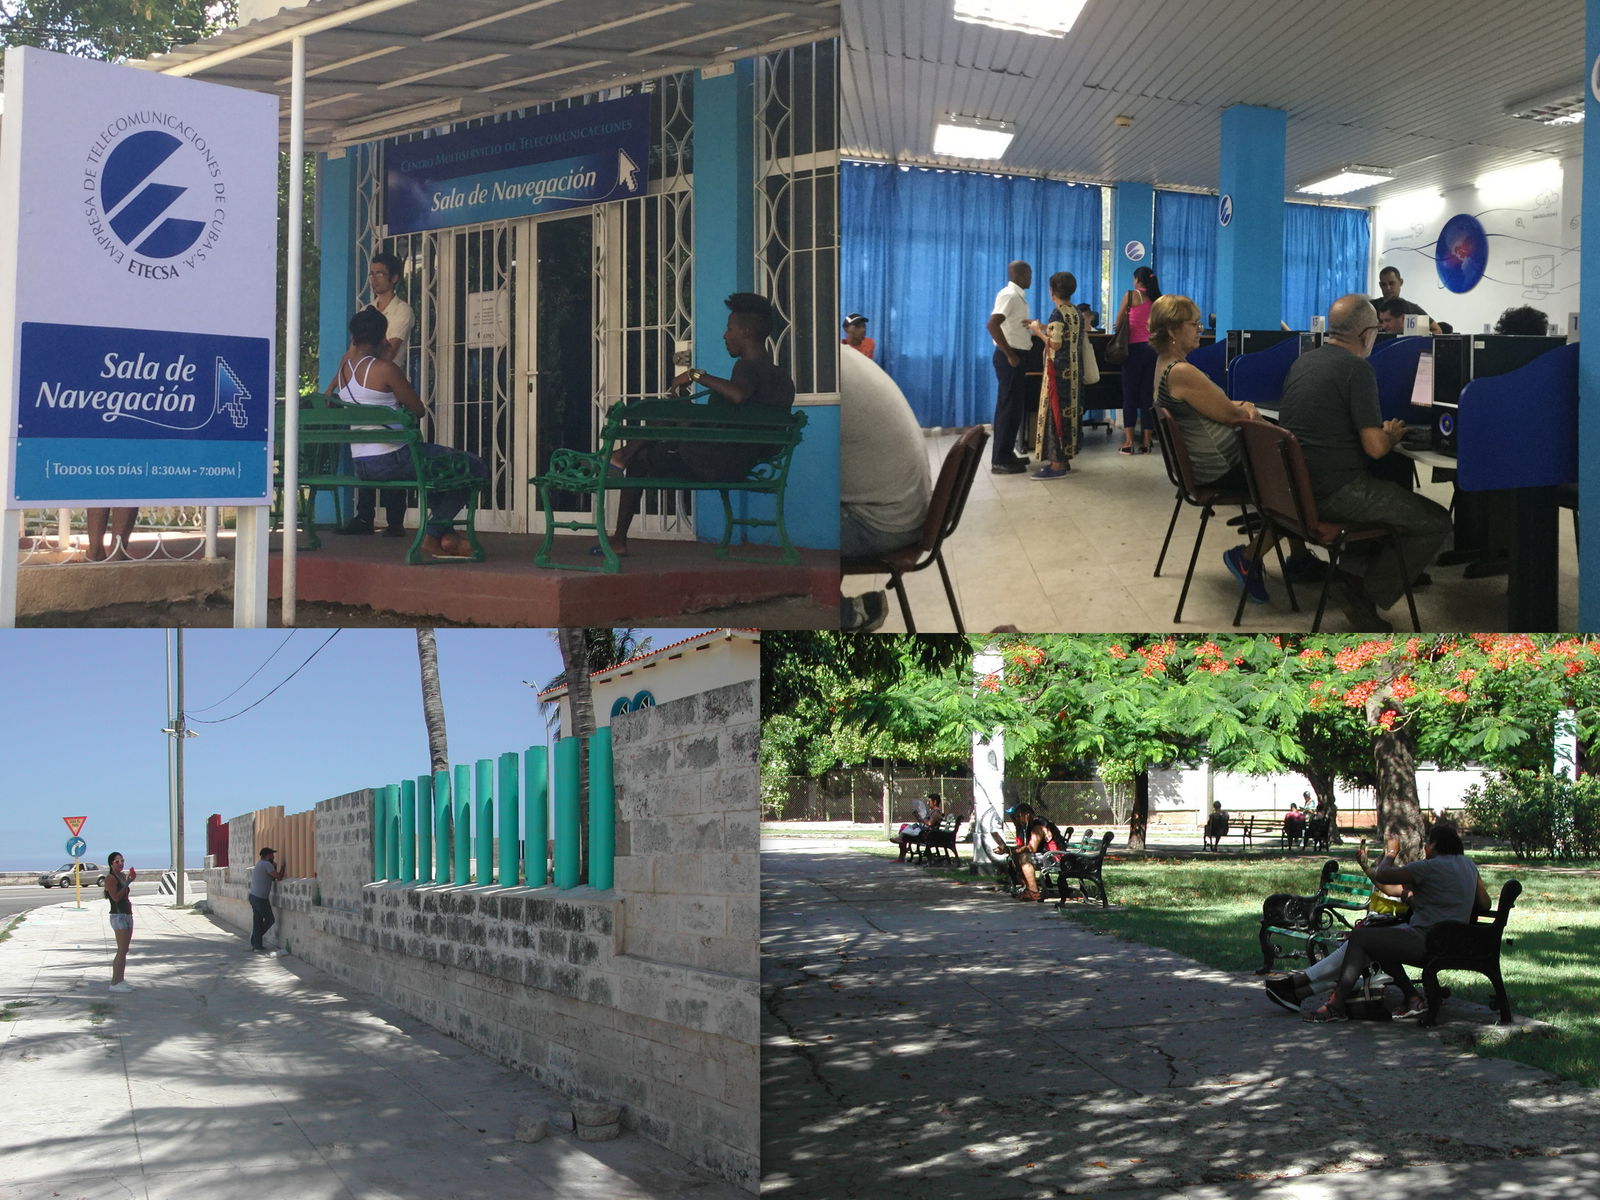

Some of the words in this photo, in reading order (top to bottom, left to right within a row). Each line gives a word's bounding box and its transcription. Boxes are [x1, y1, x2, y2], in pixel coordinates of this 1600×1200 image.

[87, 111, 222, 178] TELECOMUNICACIONES
[83, 168, 97, 191] DE
[431, 190, 464, 212] Sala
[468, 183, 488, 206] de
[491, 166, 597, 204] Navegación
[214, 182, 226, 204] DE
[84, 196, 125, 264] EMPRESA
[202, 208, 225, 250] CUBA
[128, 259, 180, 280] ETECSA
[182, 248, 206, 269] S.A.
[1406, 317, 1415, 329] 16
[100, 352, 159, 381] Sala
[165, 354, 196, 382] de
[35, 381, 196, 422] Navegación
[95, 464, 116, 476] LOS
[151, 464, 191, 476] 8:30AM
[199, 466, 236, 477] 7:00PM
